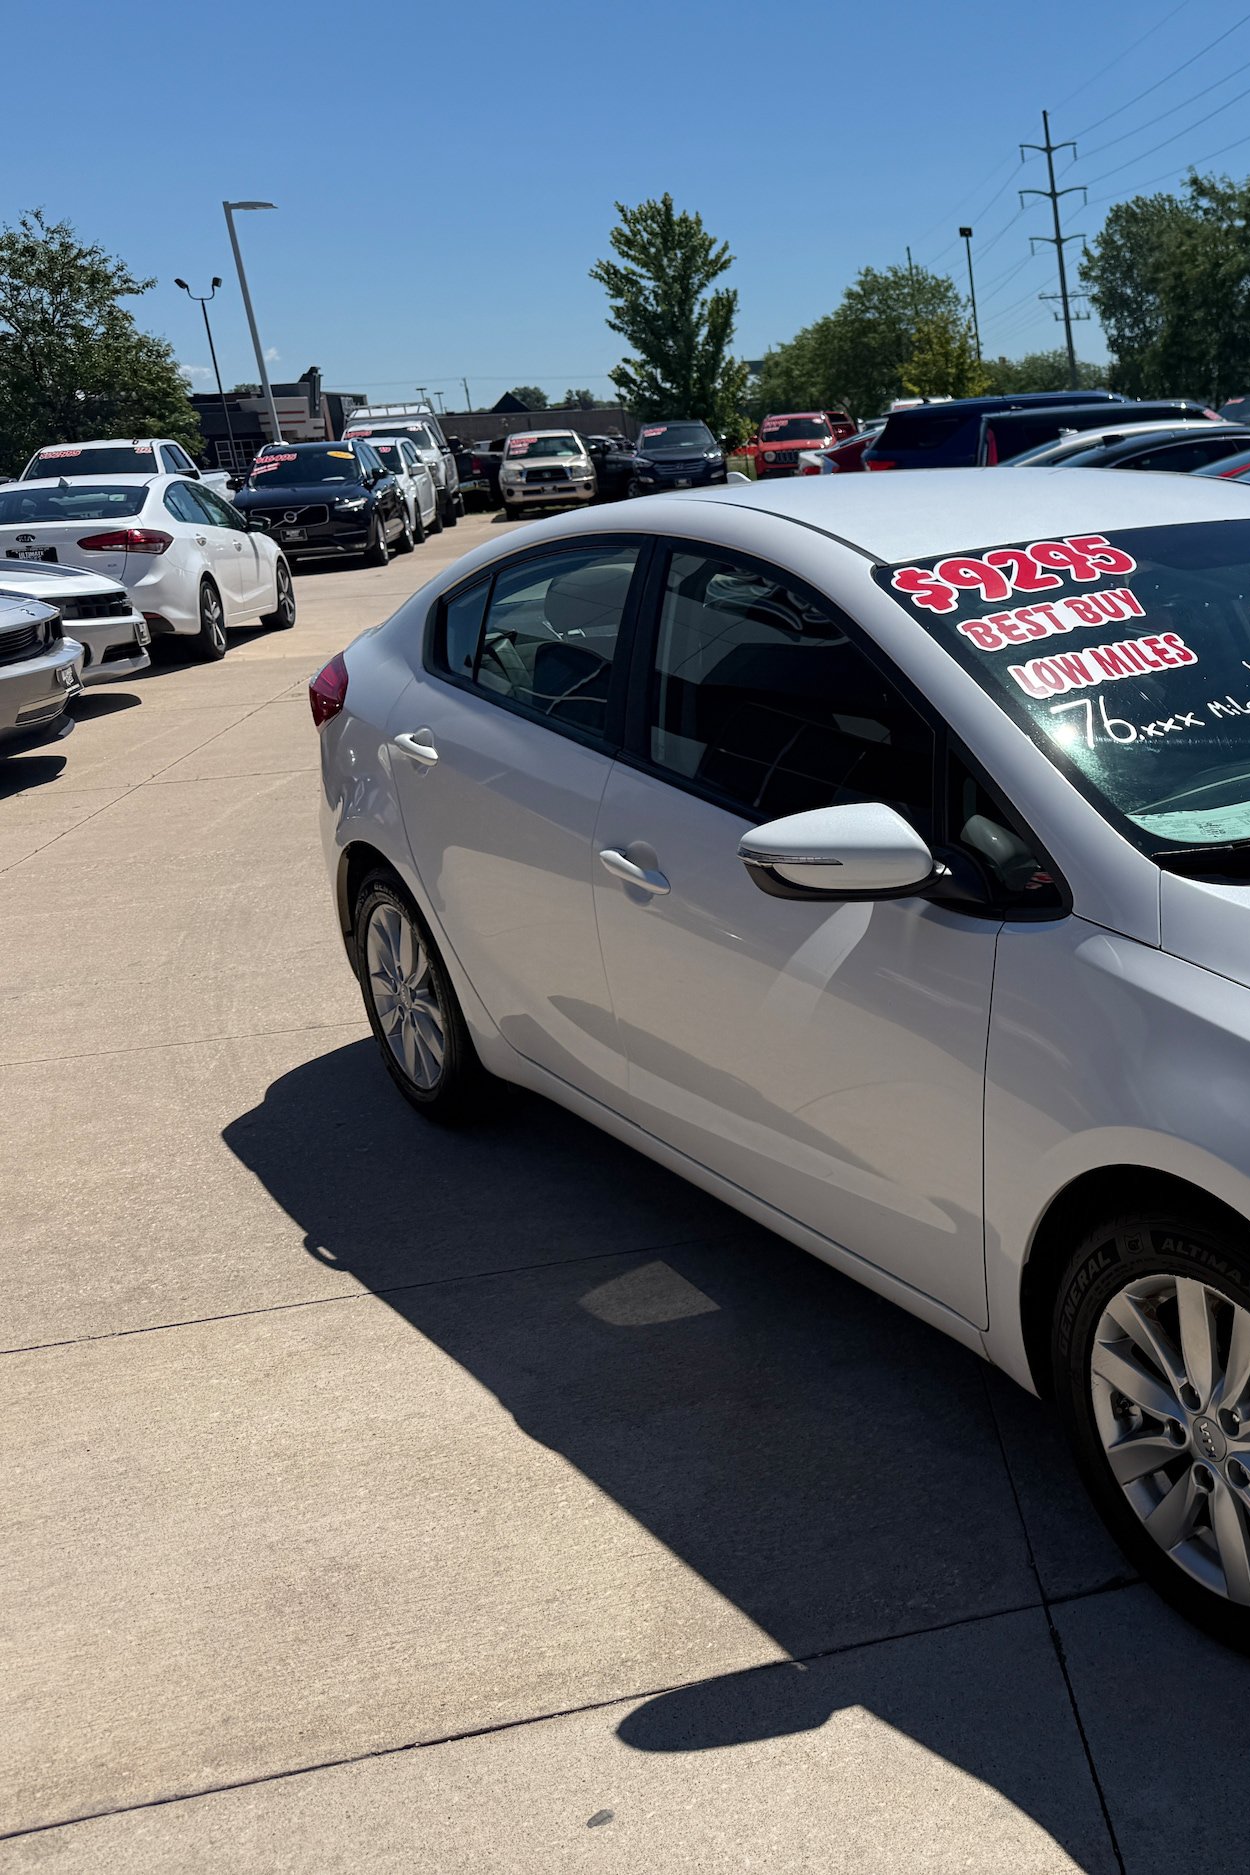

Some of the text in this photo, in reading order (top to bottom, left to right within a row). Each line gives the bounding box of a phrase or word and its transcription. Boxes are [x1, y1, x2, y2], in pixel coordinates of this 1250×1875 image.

[893, 536, 1134, 612] $9295
[961, 588, 1143, 649] BEST BUY
[1012, 633, 1193, 695] LOW MILES
[1059, 1249, 1112, 1357] GENERAL
